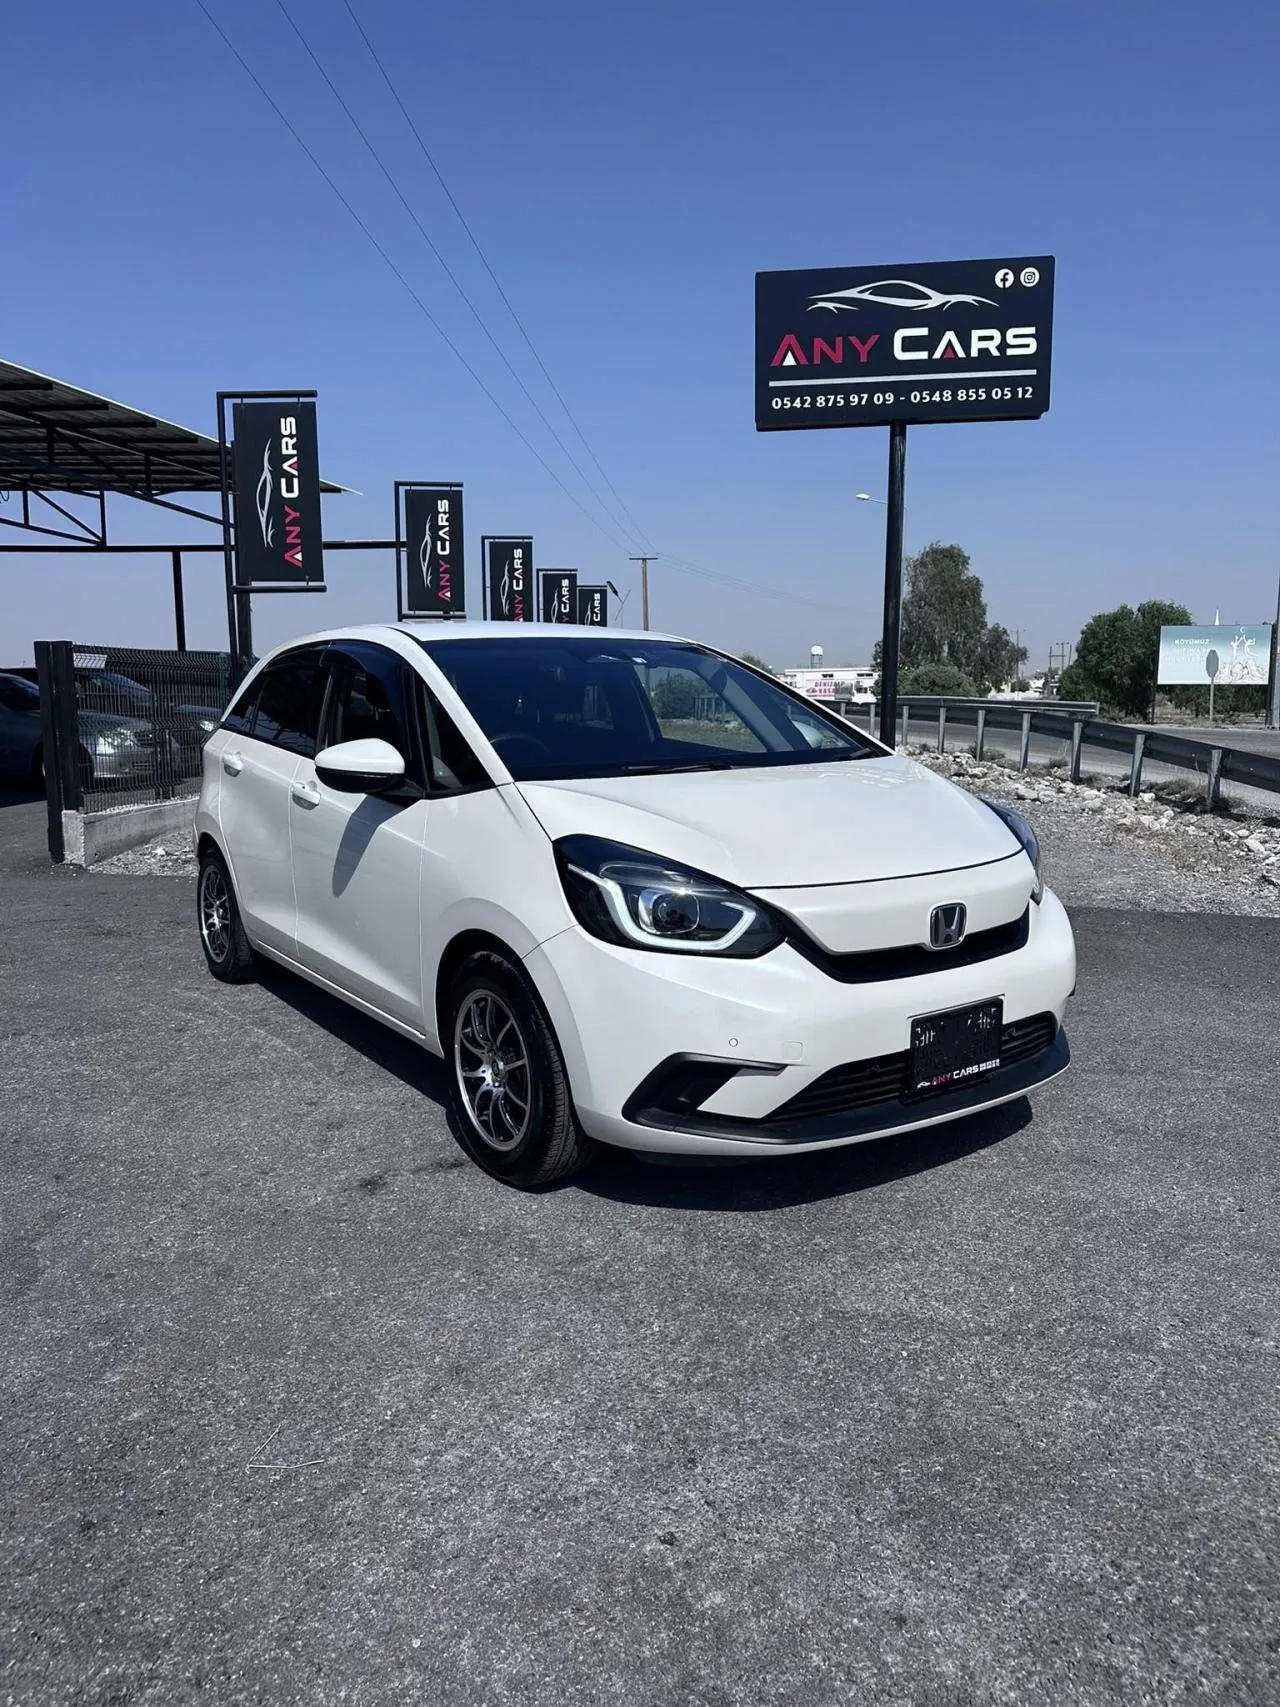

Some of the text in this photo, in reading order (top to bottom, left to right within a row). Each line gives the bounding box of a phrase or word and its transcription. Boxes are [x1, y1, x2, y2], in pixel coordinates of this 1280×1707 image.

[770, 326, 1038, 367] ANY CARS
[771, 396, 812, 410] 0542
[816, 394, 845, 408] 875
[849, 393, 869, 406] 97
[873, 392, 895, 405] 09
[910, 389, 952, 403] 0548
[957, 388, 987, 401] 855
[991, 387, 1012, 400] 05
[1016, 386, 1033, 399] 12
[280, 416, 303, 568] ANY CARS
[436, 499, 451, 602] ANY CARS
[512, 548, 523, 591] CARS
[561, 578, 570, 613] CARS
[592, 592, 601, 622] CARS
[932, 1072, 951, 1085] ANY
[953, 1064, 979, 1079] CARS
